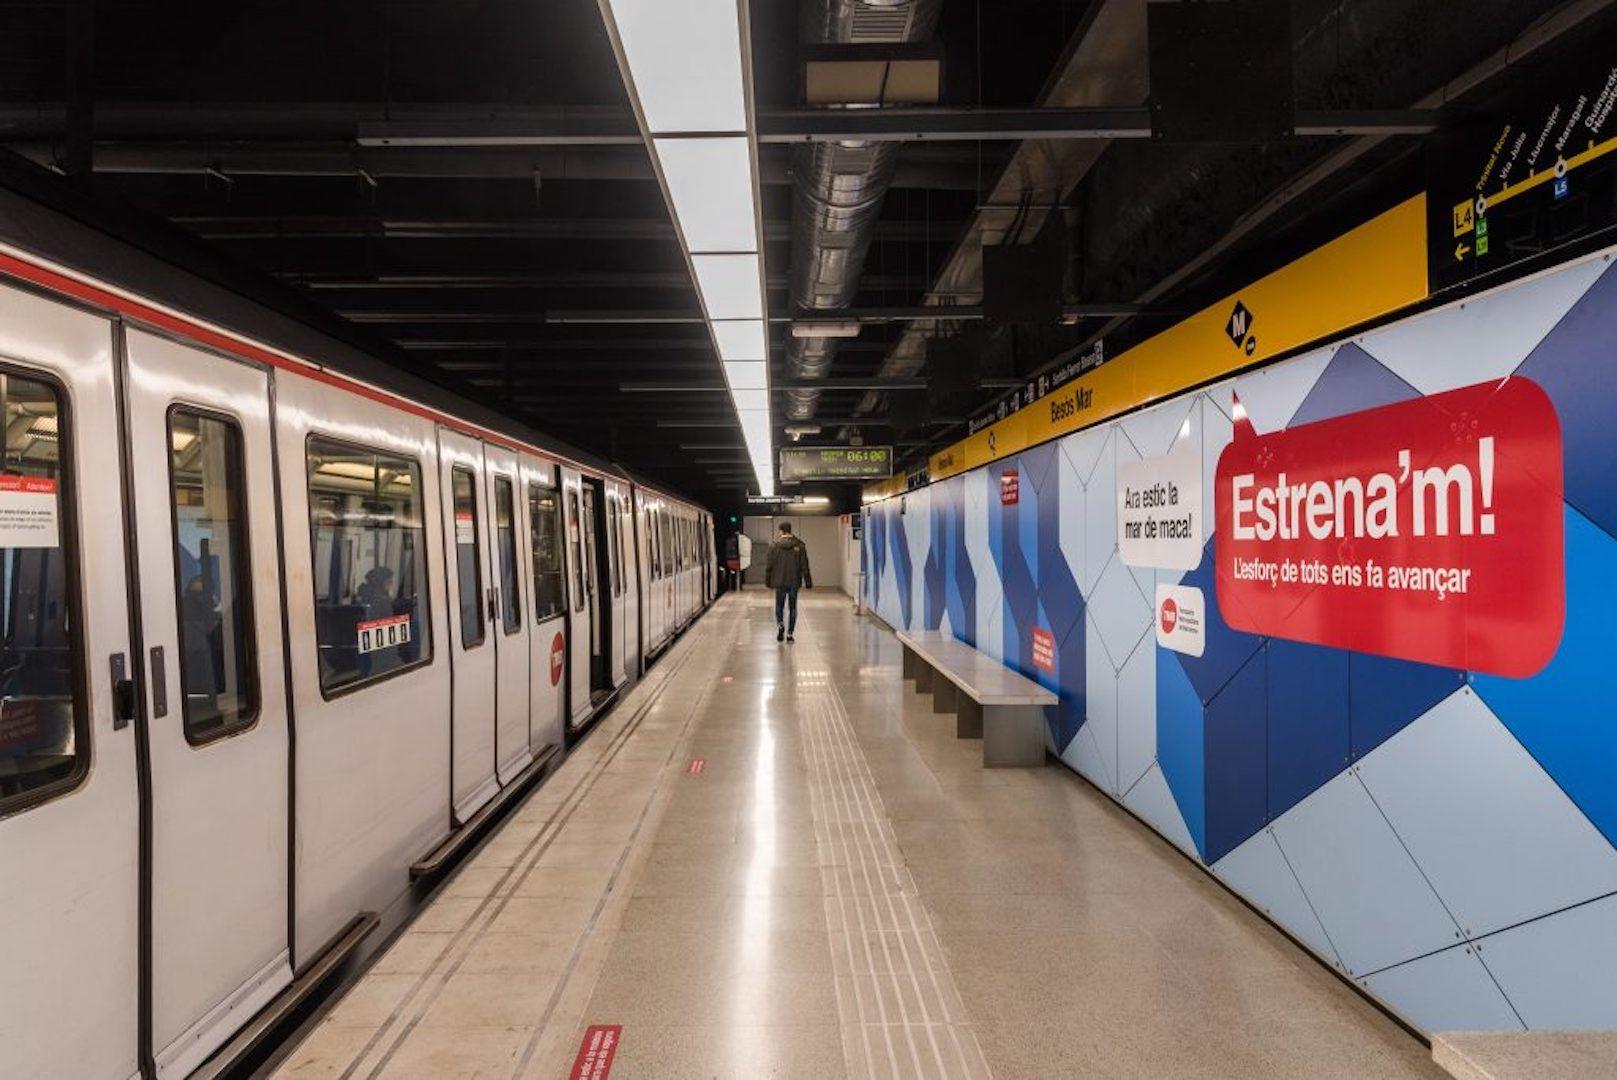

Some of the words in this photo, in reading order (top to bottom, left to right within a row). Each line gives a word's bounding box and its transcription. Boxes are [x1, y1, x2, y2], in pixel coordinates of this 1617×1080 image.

[1555, 95, 1587, 150] Maragall
[1455, 207, 1472, 229] L4
[1076, 387, 1093, 412] Mar
[847, 450, 886, 462] 06:00
[1125, 487, 1141, 509] Ara
[1143, 483, 1166, 507] estic
[1168, 481, 1178, 506] la
[1233, 436, 1496, 541] Estrena'm!
[1125, 520, 1142, 539] mar
[1144, 516, 1157, 539] de
[1159, 512, 1192, 539] maca!
[1234, 557, 1278, 588] L'esforç
[1281, 559, 1298, 583] de
[1301, 560, 1328, 585] tots
[1331, 565, 1362, 587] ens
[1366, 560, 1384, 588] fa
[1388, 567, 1471, 600] avançar
